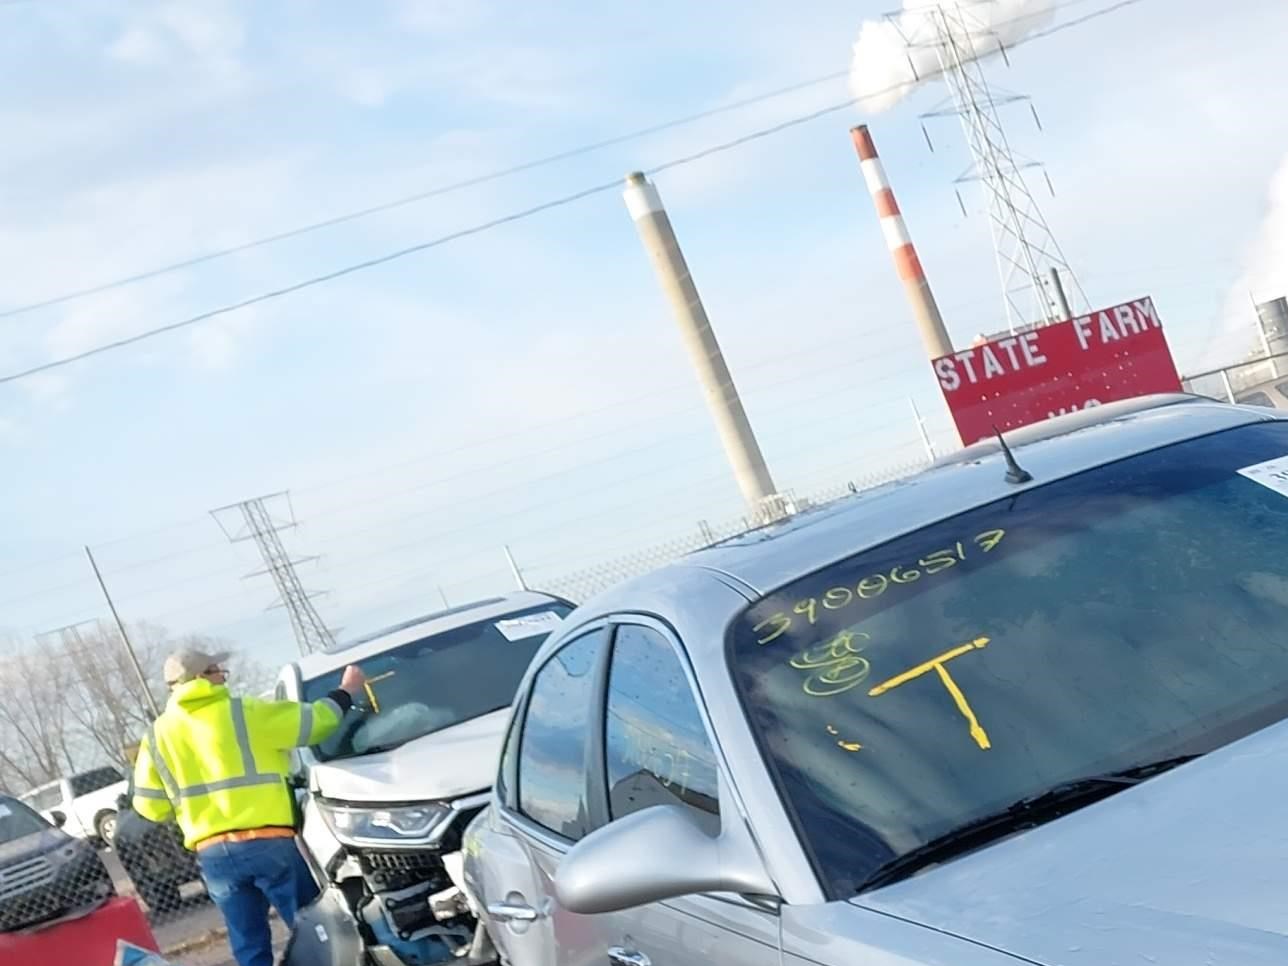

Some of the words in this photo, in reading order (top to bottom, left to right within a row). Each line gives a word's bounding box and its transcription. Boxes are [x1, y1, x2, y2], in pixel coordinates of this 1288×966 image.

[935, 332, 1047, 391] STATE
[1072, 299, 1161, 351] FARM
[752, 529, 1005, 645] 39006517
[868, 636, 991, 749] T
